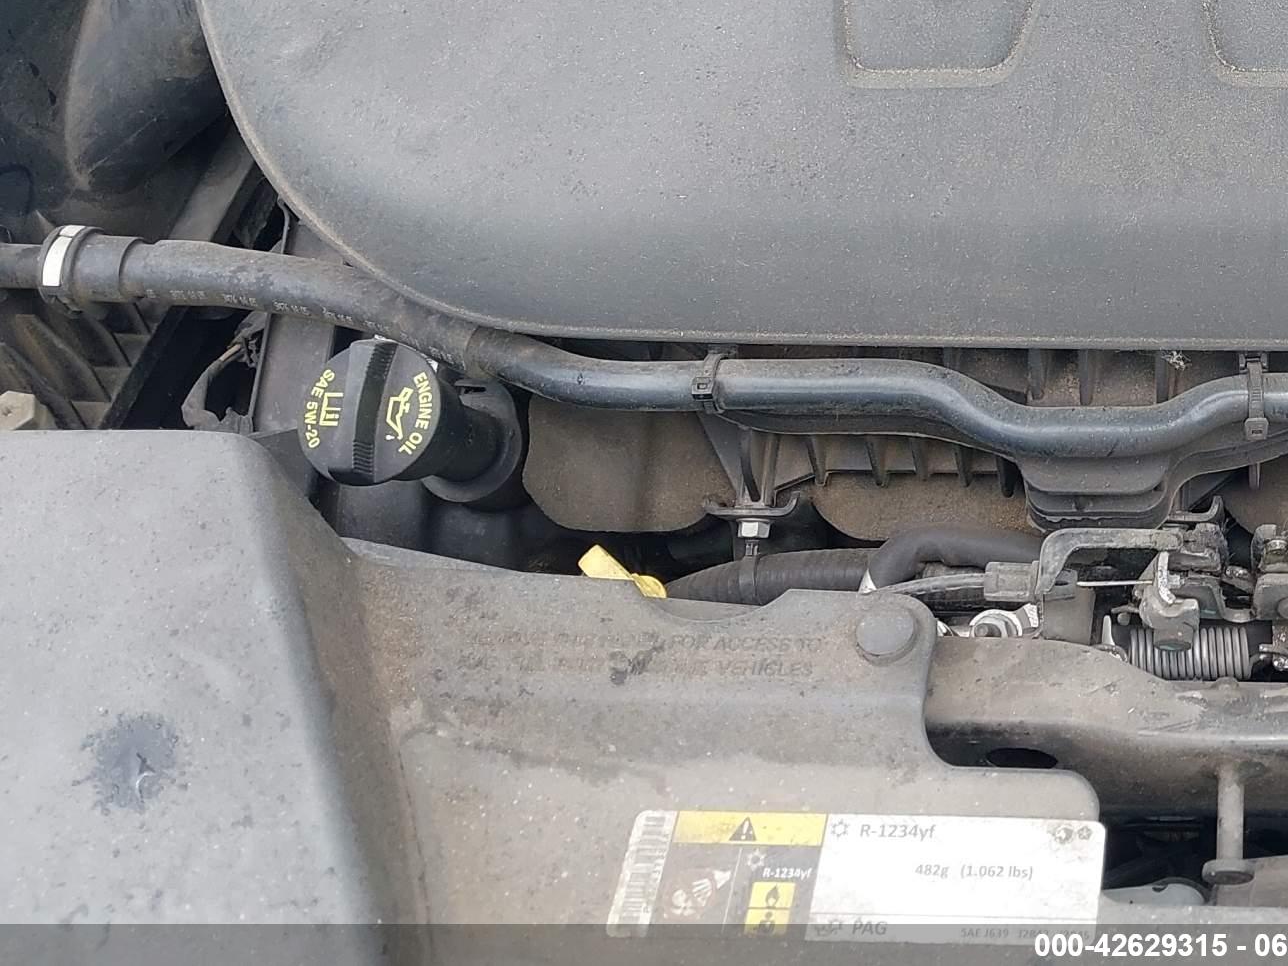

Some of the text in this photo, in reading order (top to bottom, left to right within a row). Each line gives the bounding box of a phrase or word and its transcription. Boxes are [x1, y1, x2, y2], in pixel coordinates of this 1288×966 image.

[303, 369, 336, 449] SAE 5W-20
[398, 371, 433, 455] ENGINE OIL
[859, 823, 937, 842] R-1234yf
[762, 867, 813, 880] R-1234yf
[914, 864, 1034, 880] 482g (1.062 lbs)
[852, 920, 888, 936] PAG
